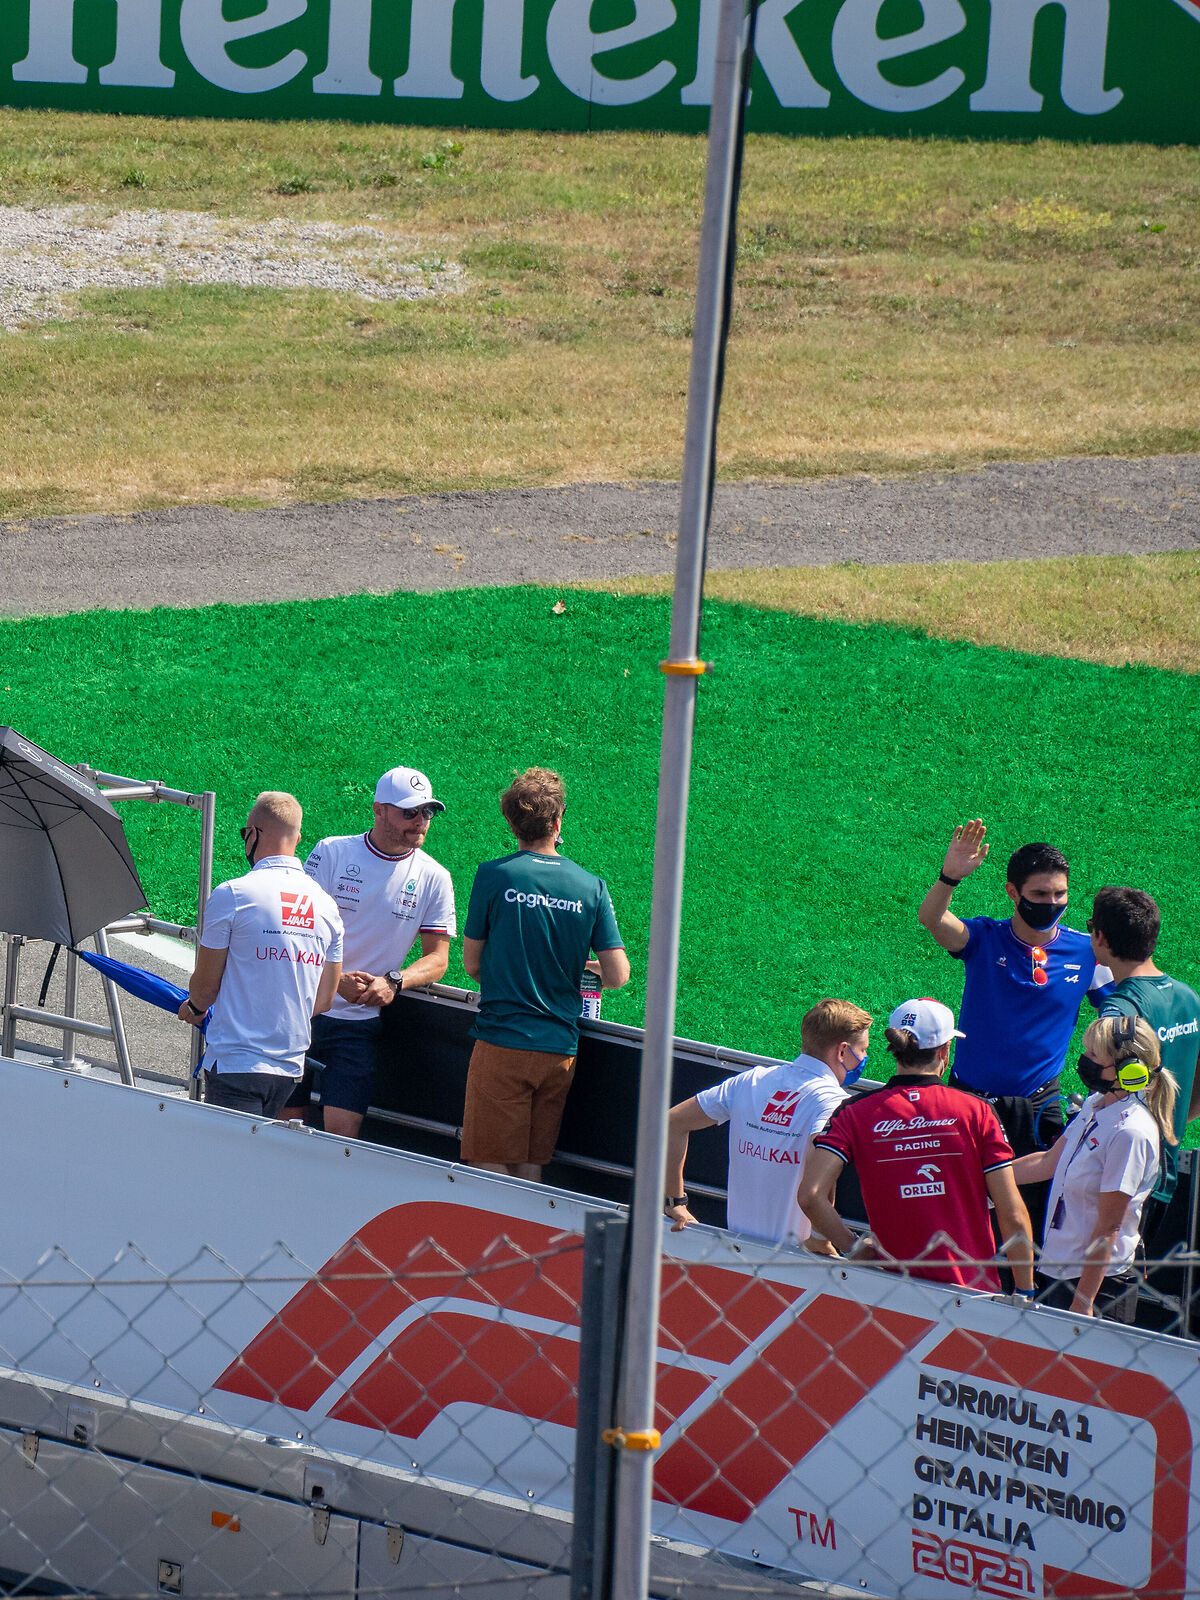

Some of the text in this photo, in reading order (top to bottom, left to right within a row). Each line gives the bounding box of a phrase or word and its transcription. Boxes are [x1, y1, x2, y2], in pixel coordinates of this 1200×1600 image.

[345, 885, 360, 894] UBS
[504, 888, 583, 913] Cognizant
[281, 914, 314, 928] HAAS
[582, 999, 591, 1018] BWT
[873, 1116, 958, 1137] Alfa Romeo
[895, 1140, 941, 1151] RACING
[903, 1184, 942, 1196] ORLEN
[918, 1373, 1093, 1443] FORMULA 1
[915, 1413, 1069, 1478] HEINEKEN
[914, 1455, 1127, 1533] GRAN PREMIO
[788, 1507, 837, 1550] TM
[912, 1493, 1037, 1551] D'ITALIA
[911, 1528, 1036, 1600] 2021
